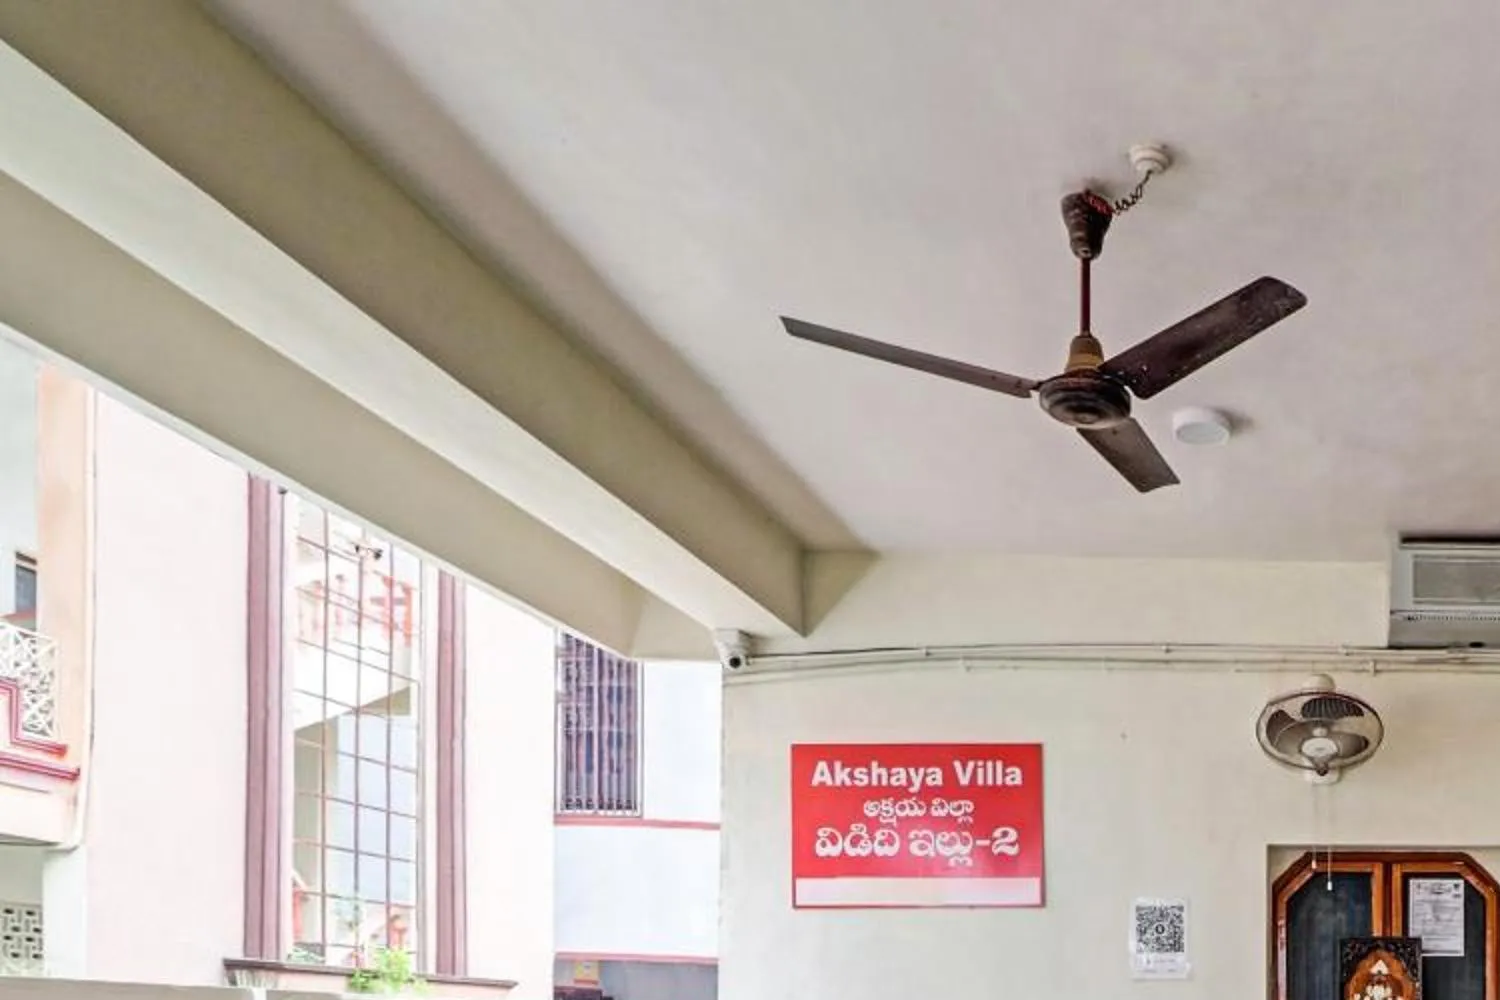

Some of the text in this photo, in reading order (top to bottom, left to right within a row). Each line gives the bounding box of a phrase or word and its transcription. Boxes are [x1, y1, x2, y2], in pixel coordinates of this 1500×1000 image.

[811, 760, 1023, 793] Akshaya Villa
[863, 797, 975, 827] అక్షయ విల్లా
